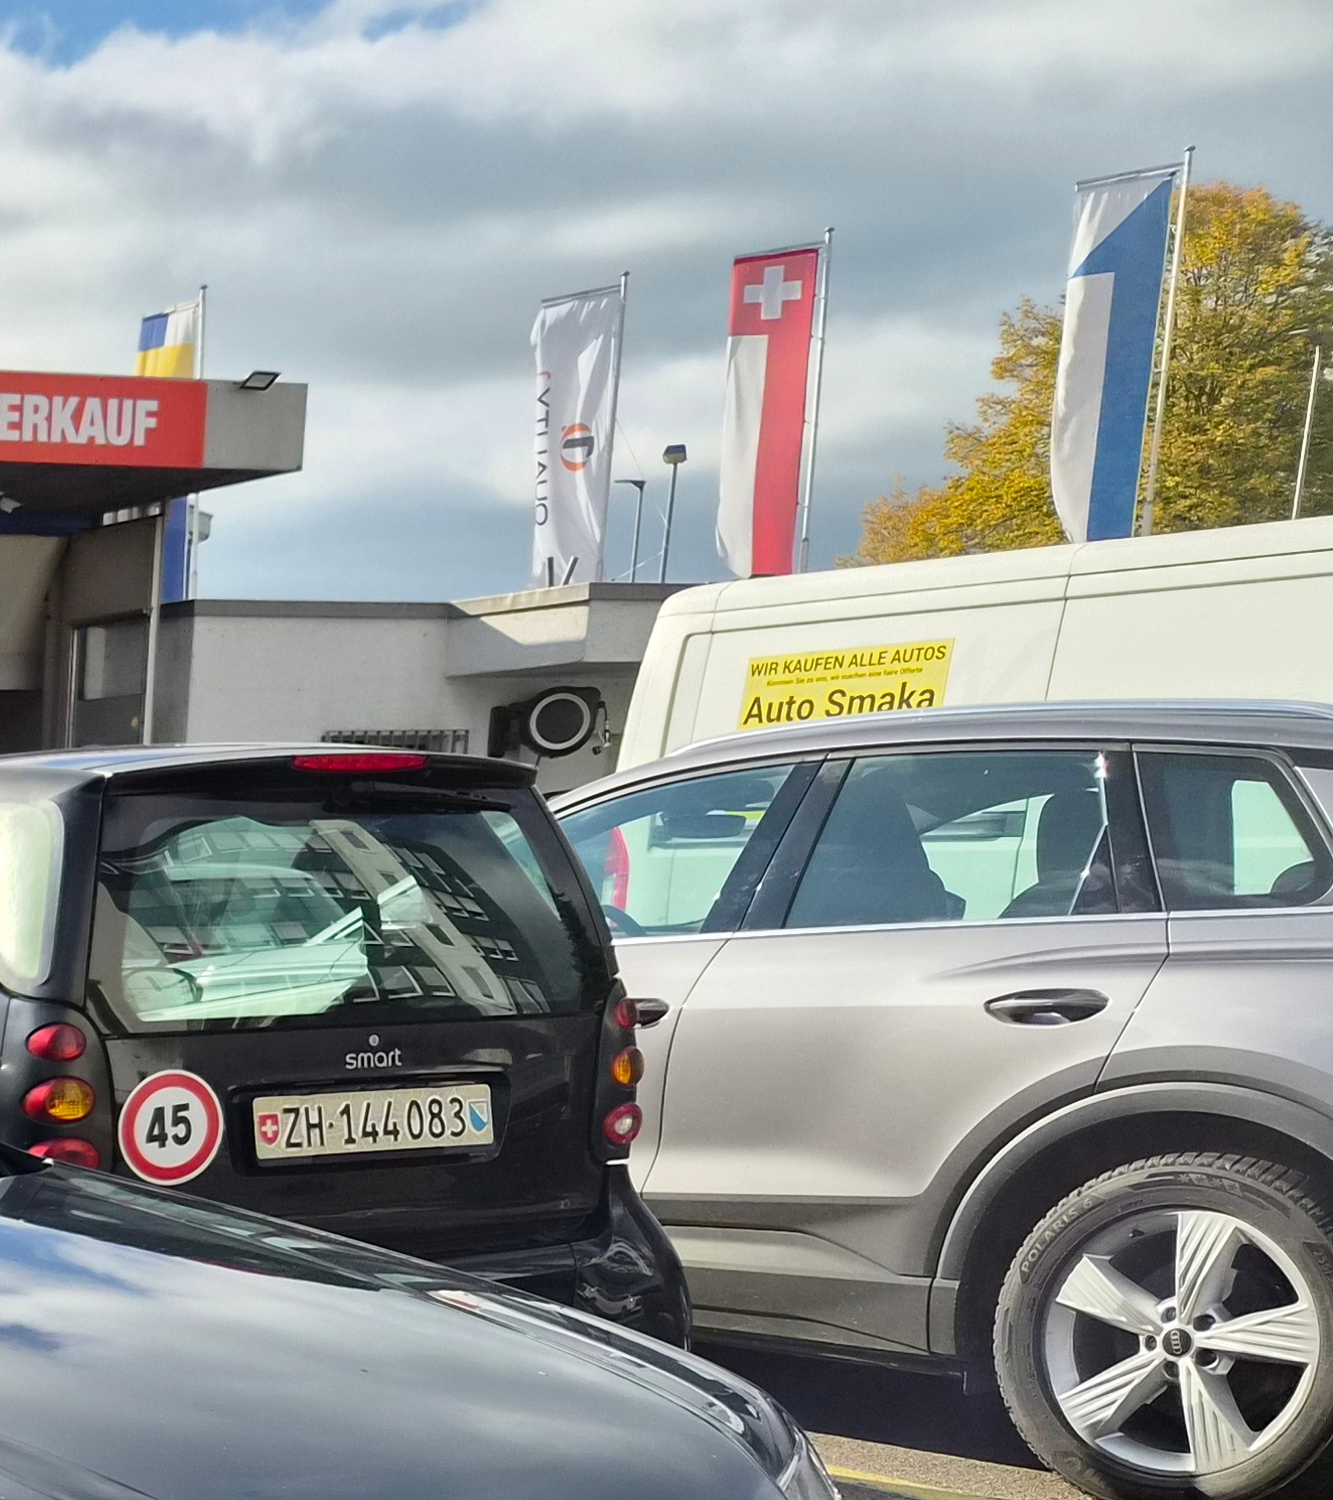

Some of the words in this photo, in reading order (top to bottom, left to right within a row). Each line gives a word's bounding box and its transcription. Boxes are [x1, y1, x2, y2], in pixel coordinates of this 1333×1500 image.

[751, 661, 778, 677] WIR
[783, 654, 844, 675] KAUFEN
[848, 650, 888, 668] ALLE
[890, 645, 947, 664] AUTOS
[743, 695, 815, 726] Auto
[824, 682, 935, 718] Smaka
[345, 1047, 402, 1070] smart
[145, 1102, 192, 1149] 45
[1021, 1207, 1078, 1273] POLARIS
